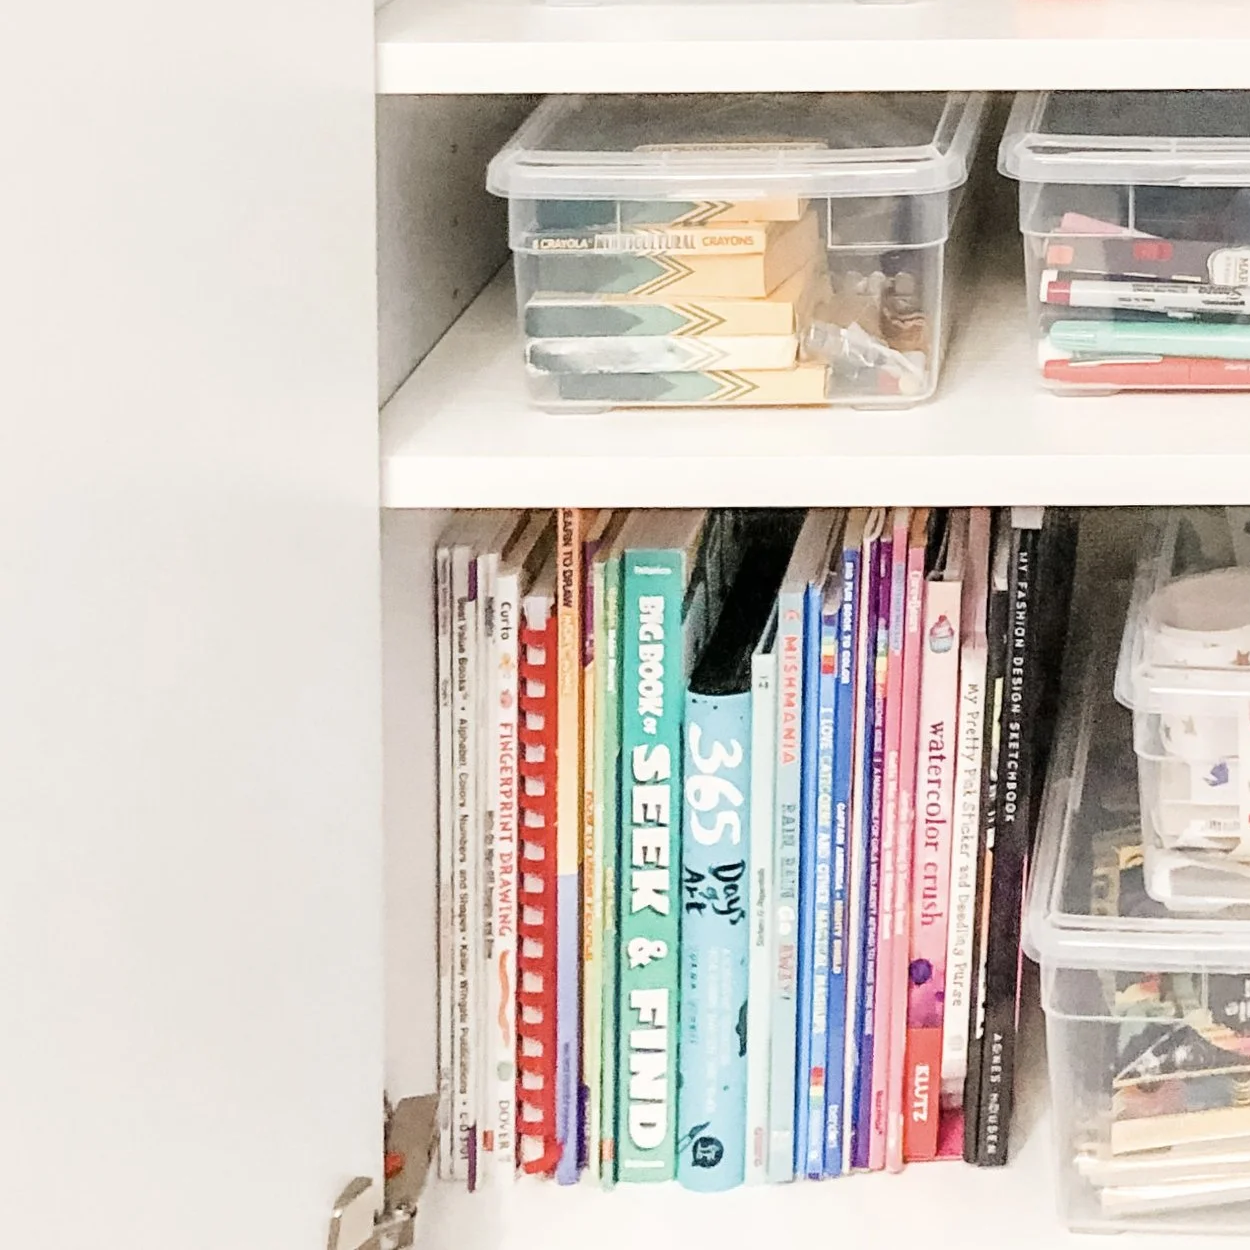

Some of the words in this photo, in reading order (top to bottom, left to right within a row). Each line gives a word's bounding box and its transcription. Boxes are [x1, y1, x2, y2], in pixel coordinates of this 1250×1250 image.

[703, 236, 754, 246] CRAYONS
[562, 551, 573, 568] TO
[844, 562, 854, 580] BIG
[1018, 552, 1028, 571] MY
[562, 570, 574, 608] DRAW
[844, 582, 854, 601] FUN
[500, 602, 512, 640] Curto
[638, 596, 665, 642] BIG
[843, 603, 853, 632] BOOK
[1014, 582, 1028, 648] FASHION
[458, 625, 468, 654] Value
[842, 636, 852, 648] TO
[458, 658, 469, 692] Books
[638, 644, 664, 716] BOOK
[841, 650, 852, 684] COLOR
[1010, 657, 1024, 714] DESIGN
[782, 636, 798, 764] MISHMANIA
[966, 684, 979, 704] My
[642, 717, 658, 735] OF
[820, 718, 832, 748] LOVE
[960, 712, 979, 761] Pretty
[500, 722, 513, 843] FINGERPRINT
[686, 722, 744, 845] 365
[923, 721, 947, 851] watercolor
[962, 769, 978, 797] Pink
[1004, 722, 1020, 822] SKETCHBOOK
[630, 744, 671, 916] SEEK
[836, 802, 846, 844] CAPTAIN
[960, 802, 976, 856] Sticker
[460, 869, 470, 889] and
[817, 863, 830, 904] OTHER
[834, 846, 844, 890] AMERICA
[958, 864, 972, 888] and
[456, 893, 470, 932] Shapes
[499, 853, 512, 937] DRAWING
[684, 866, 707, 918] Art
[710, 860, 747, 926] Days
[920, 862, 942, 926] crush
[778, 905, 796, 936] Go
[952, 894, 970, 956] Doodling
[627, 937, 668, 970] &
[778, 944, 794, 1000] AWAY!
[457, 980, 470, 1023] Wingate
[952, 962, 968, 1007] Purse
[459, 1027, 470, 1094] Publications
[627, 988, 668, 1150] FIND
[990, 1033, 1002, 1084] AGNES
[912, 1064, 930, 1122] KLUTZ
[499, 1100, 510, 1150] DOVER
